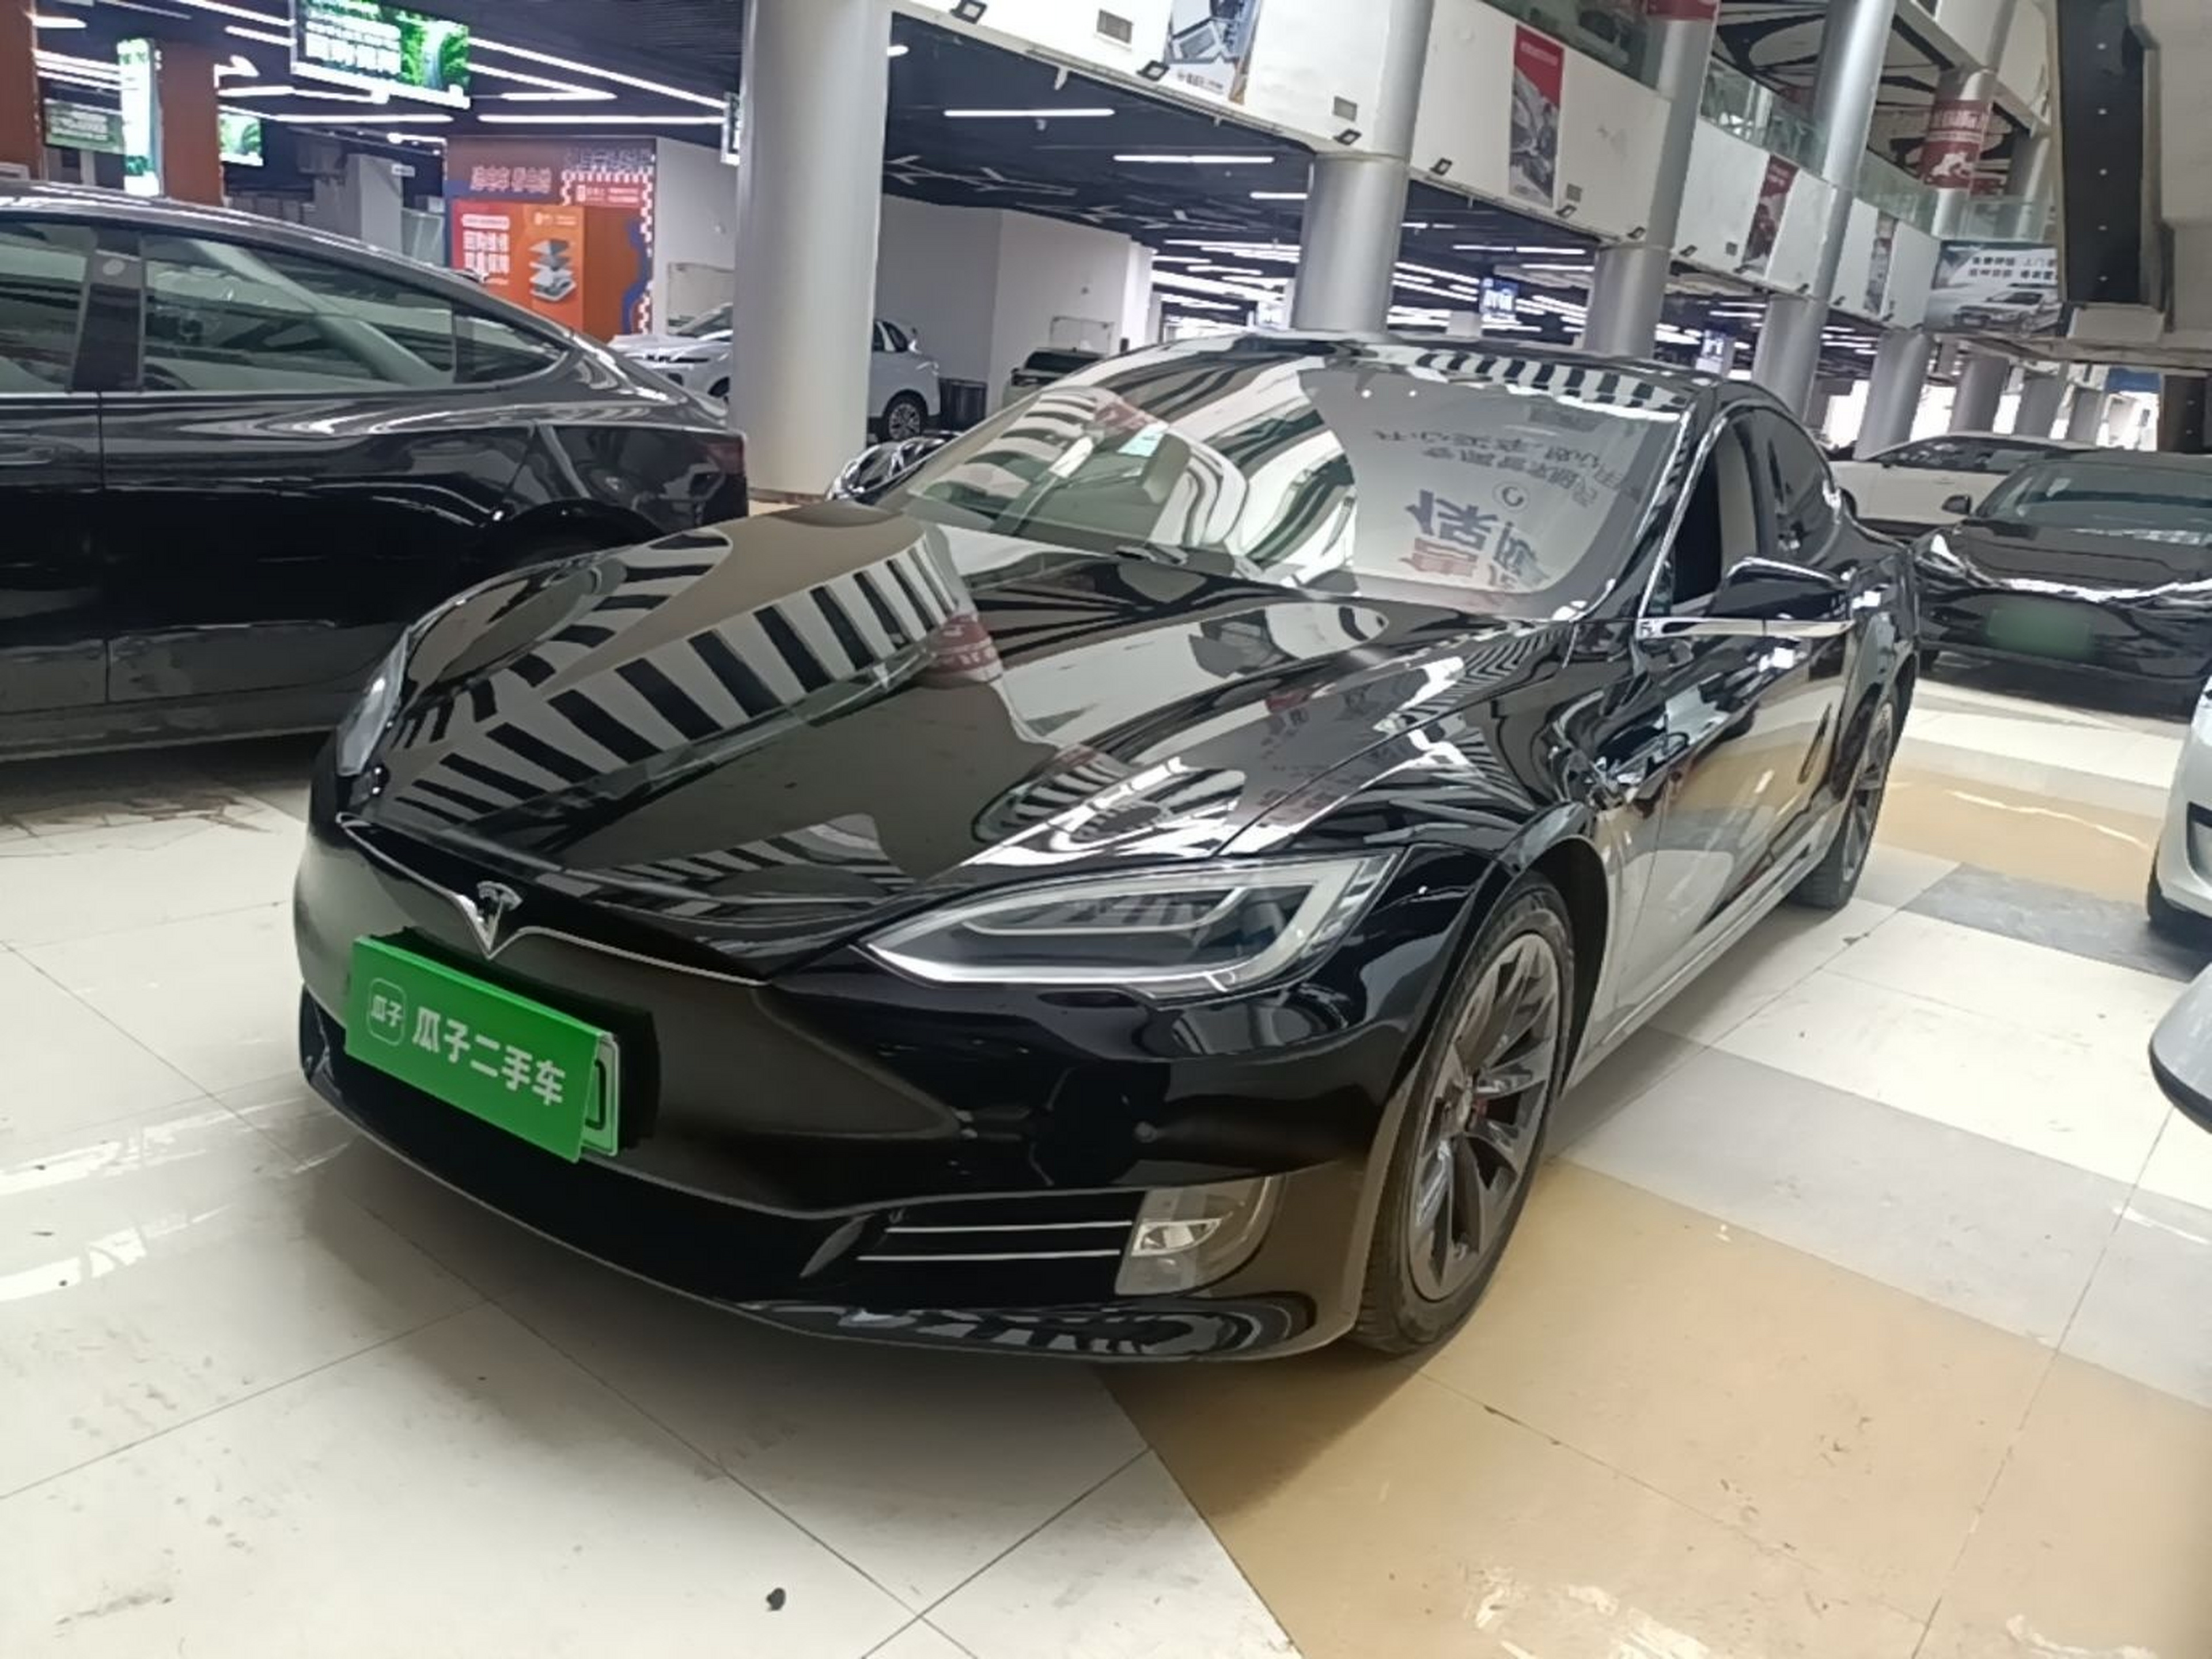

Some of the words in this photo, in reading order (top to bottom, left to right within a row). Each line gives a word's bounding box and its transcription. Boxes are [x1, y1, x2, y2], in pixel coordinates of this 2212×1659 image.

[370, 994, 403, 1028] 瓜子
[412, 1006, 566, 1105] 瓜子二手车
